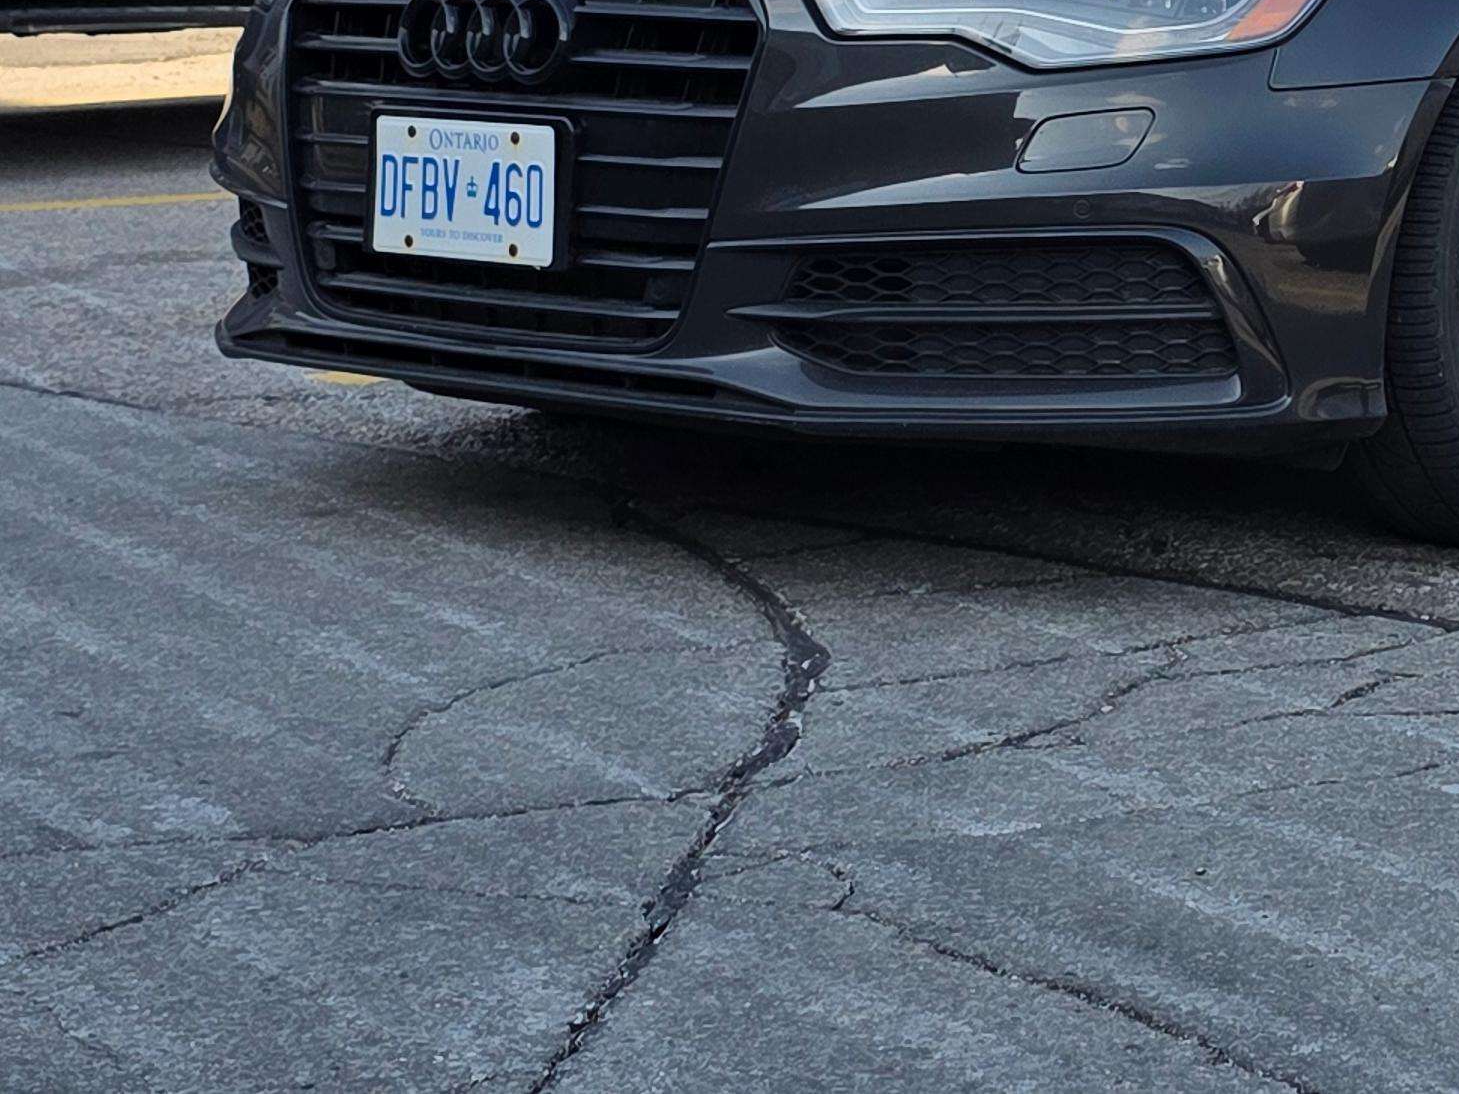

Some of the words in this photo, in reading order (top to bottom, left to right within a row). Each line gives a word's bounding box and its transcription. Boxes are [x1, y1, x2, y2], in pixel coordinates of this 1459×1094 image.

[429, 128, 499, 154] ONTARIO
[380, 154, 460, 222] DFBV
[483, 161, 544, 228] 460
